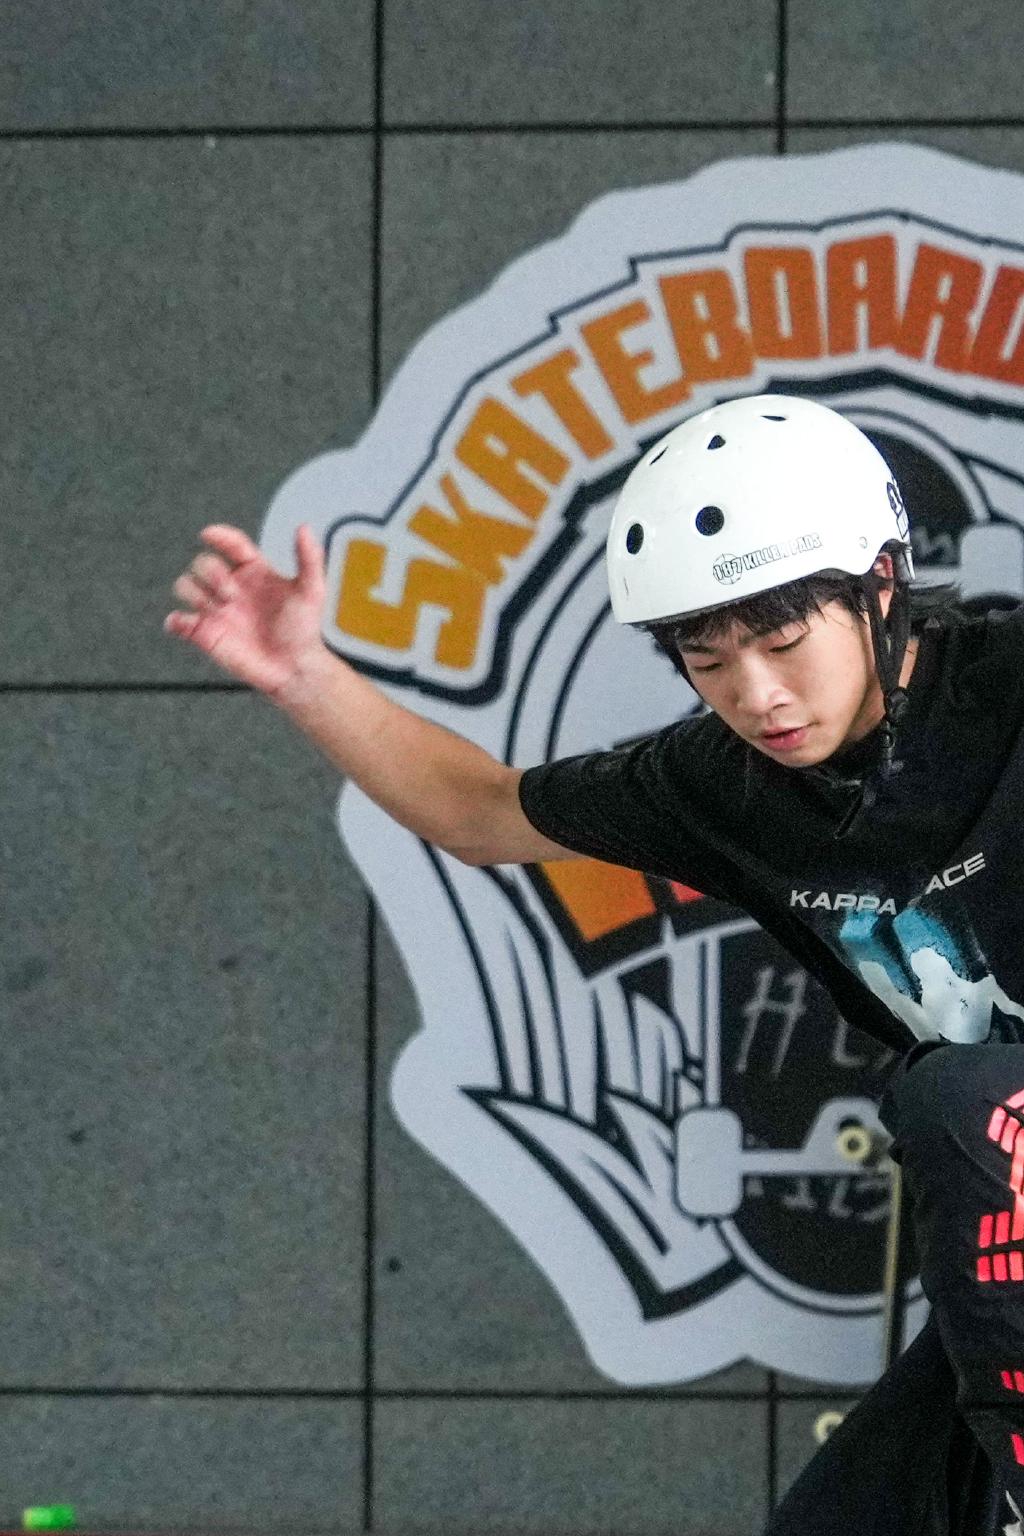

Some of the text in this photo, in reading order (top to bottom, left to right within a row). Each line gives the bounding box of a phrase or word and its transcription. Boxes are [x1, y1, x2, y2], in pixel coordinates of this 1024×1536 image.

[713, 557, 742, 580] 187
[789, 534, 823, 555] PADS
[790, 852, 986, 915] KAPPA ACE
